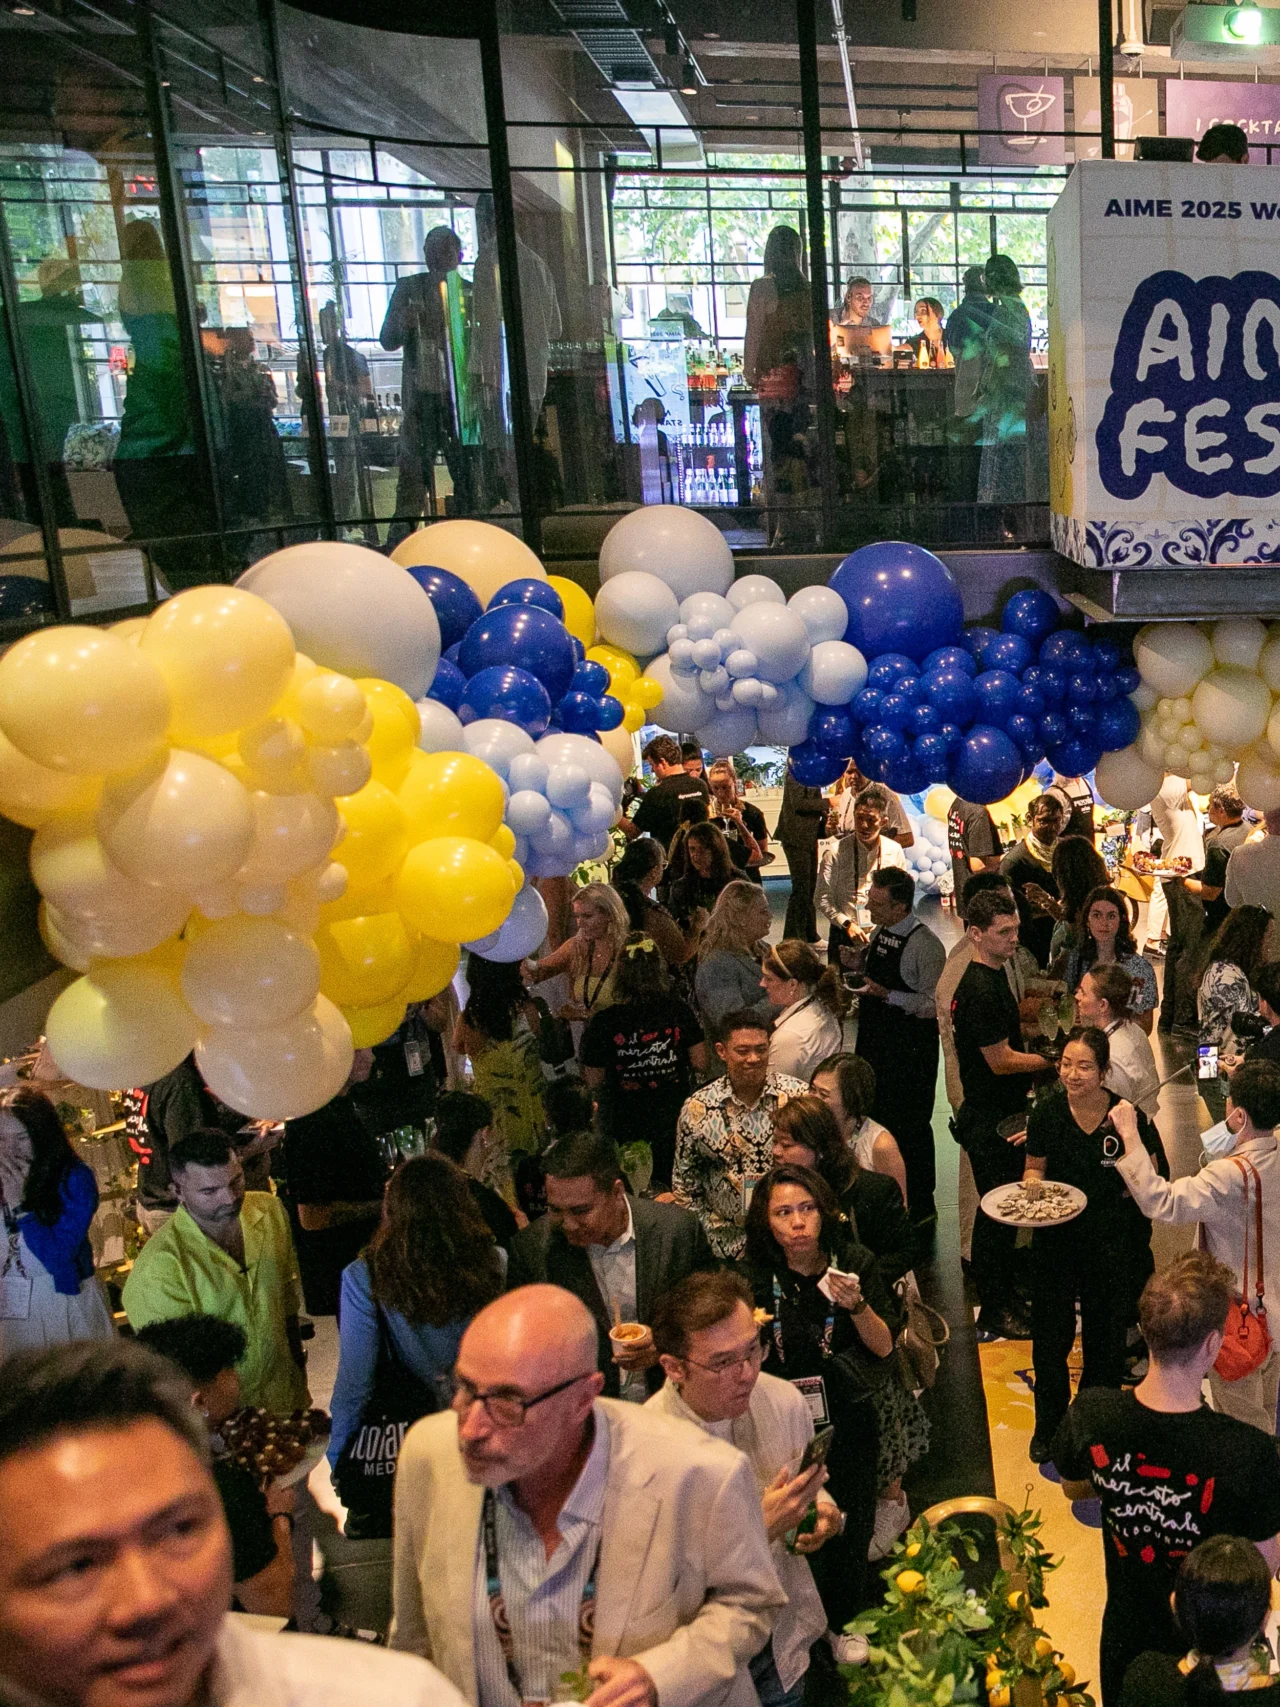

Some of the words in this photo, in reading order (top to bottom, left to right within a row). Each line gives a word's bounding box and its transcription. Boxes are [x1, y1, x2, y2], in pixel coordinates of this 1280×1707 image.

[1104, 199, 1173, 218] AIME
[1181, 200, 1243, 219] 2025
[364, 1460, 396, 1477] MED
[1112, 1453, 1131, 1472] il
[1092, 1469, 1192, 1507] mercato
[1109, 1501, 1200, 1535] centrale
